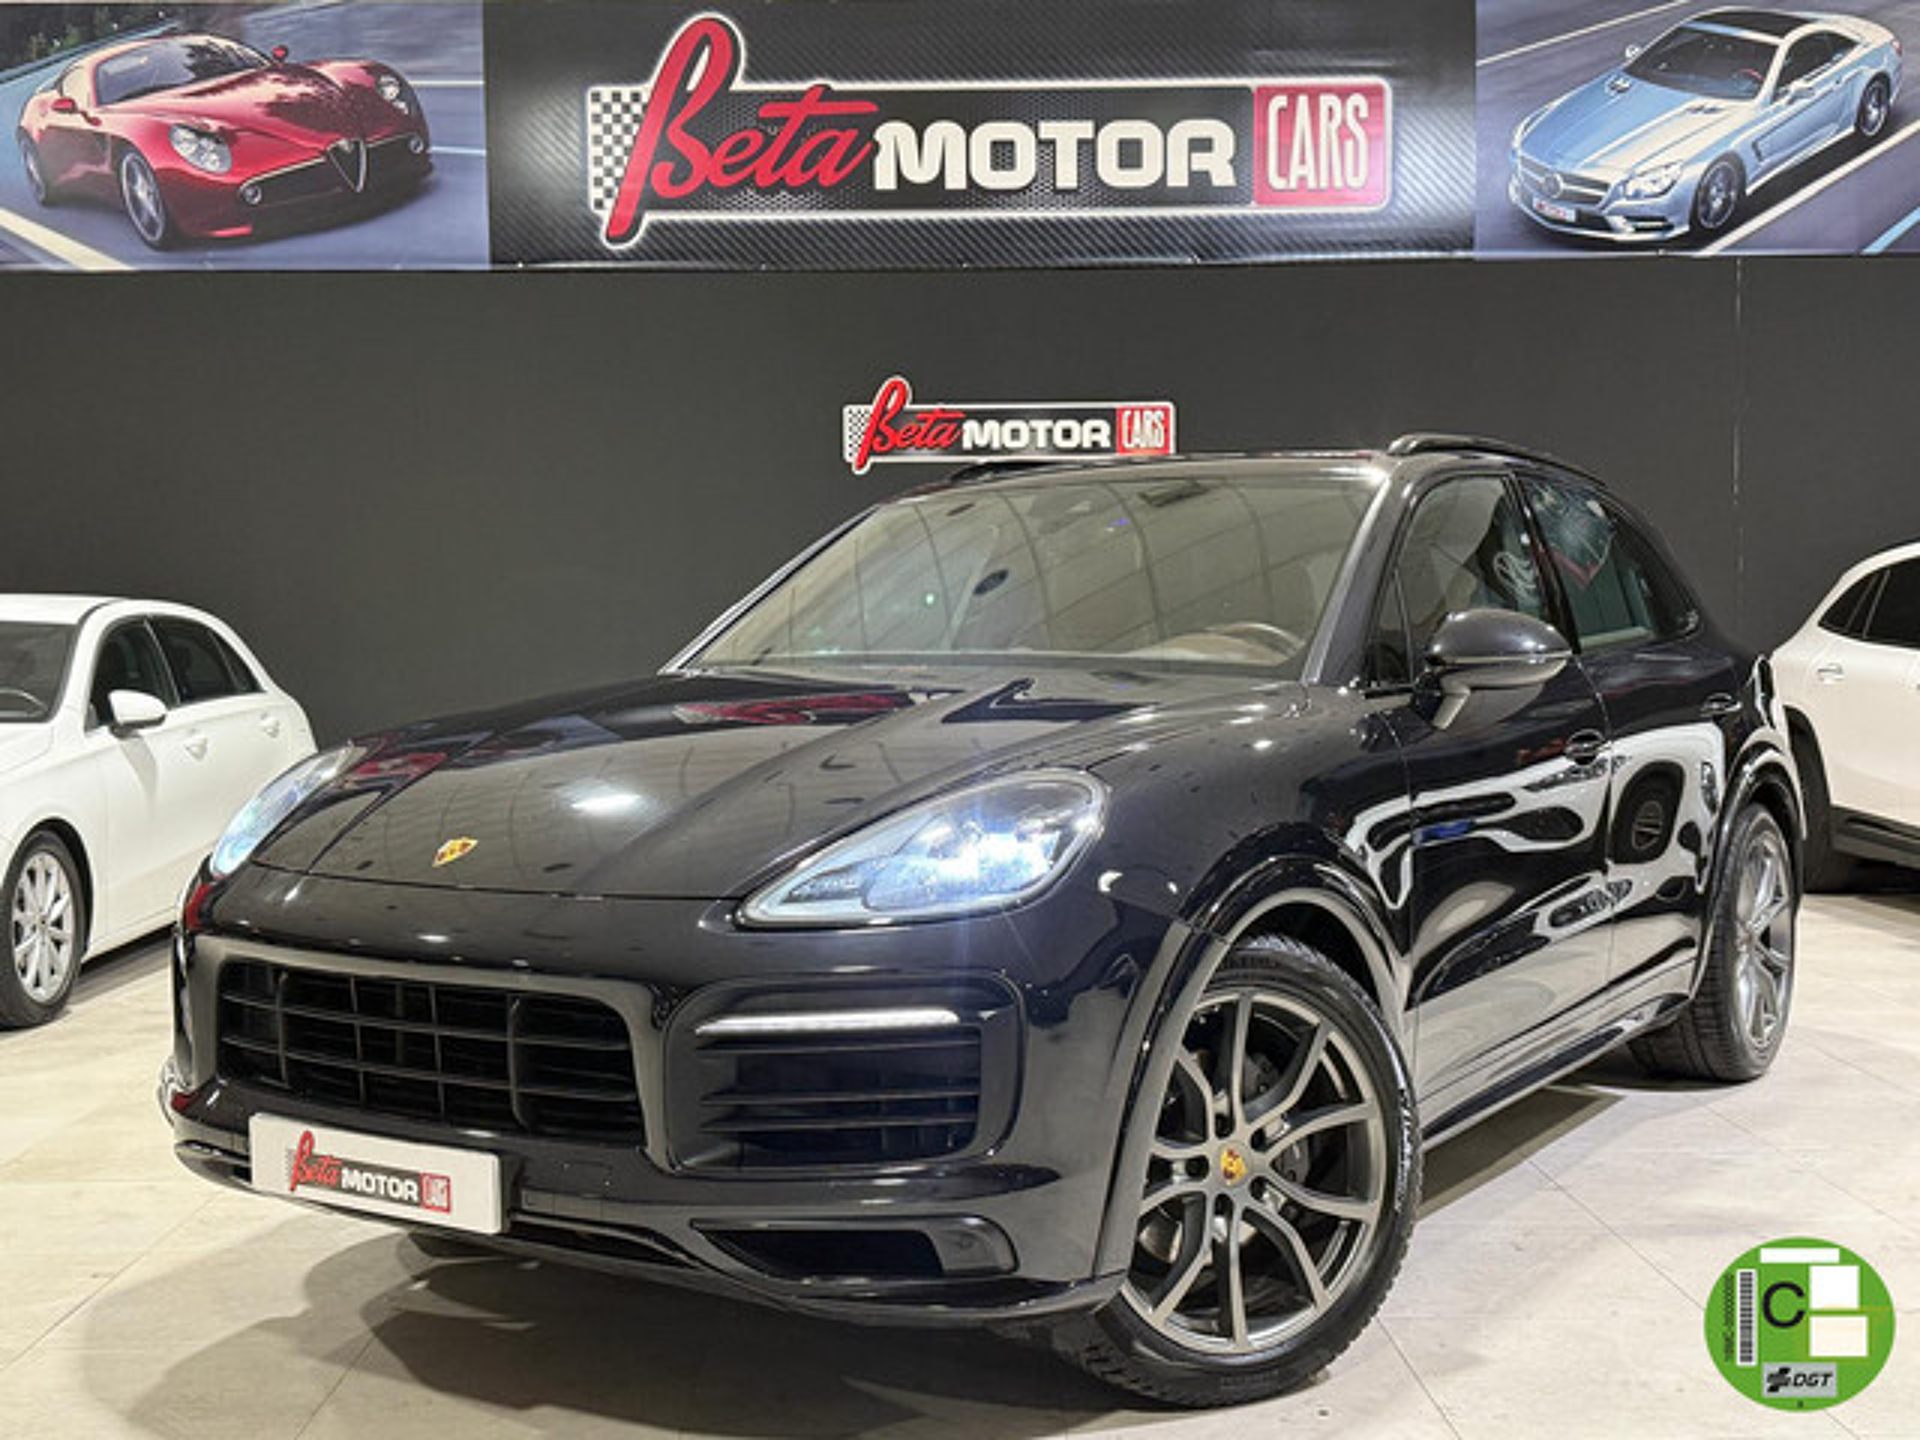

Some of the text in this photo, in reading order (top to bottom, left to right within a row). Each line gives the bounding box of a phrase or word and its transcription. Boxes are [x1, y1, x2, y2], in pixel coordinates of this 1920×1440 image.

[606, 17, 1368, 239] Beta MOTOR CARS
[856, 379, 1166, 470] Beta MOTOR CARS
[341, 1168, 419, 1202] MOTOR
